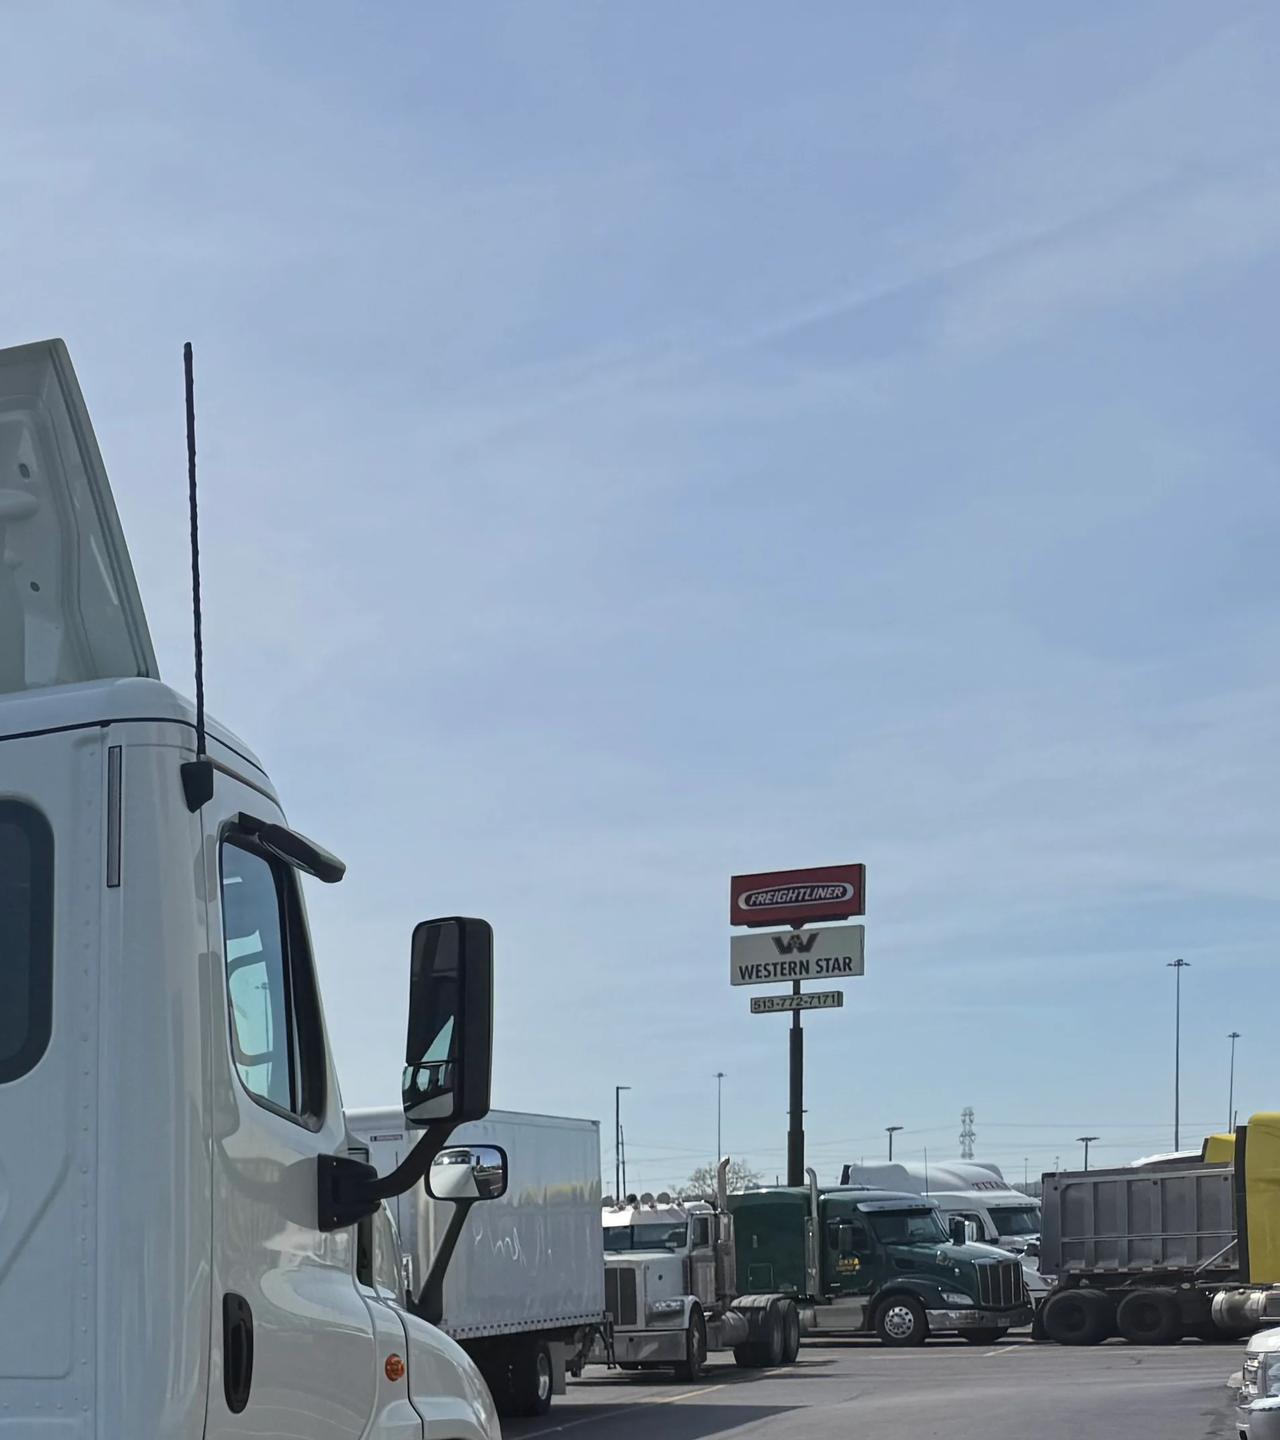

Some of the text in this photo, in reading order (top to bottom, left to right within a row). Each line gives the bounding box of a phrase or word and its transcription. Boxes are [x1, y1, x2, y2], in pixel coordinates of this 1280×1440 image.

[748, 885, 844, 906] FREIGHTLINER
[738, 956, 853, 980] WESTERN STAR
[752, 993, 836, 1011] 513-772-7171
